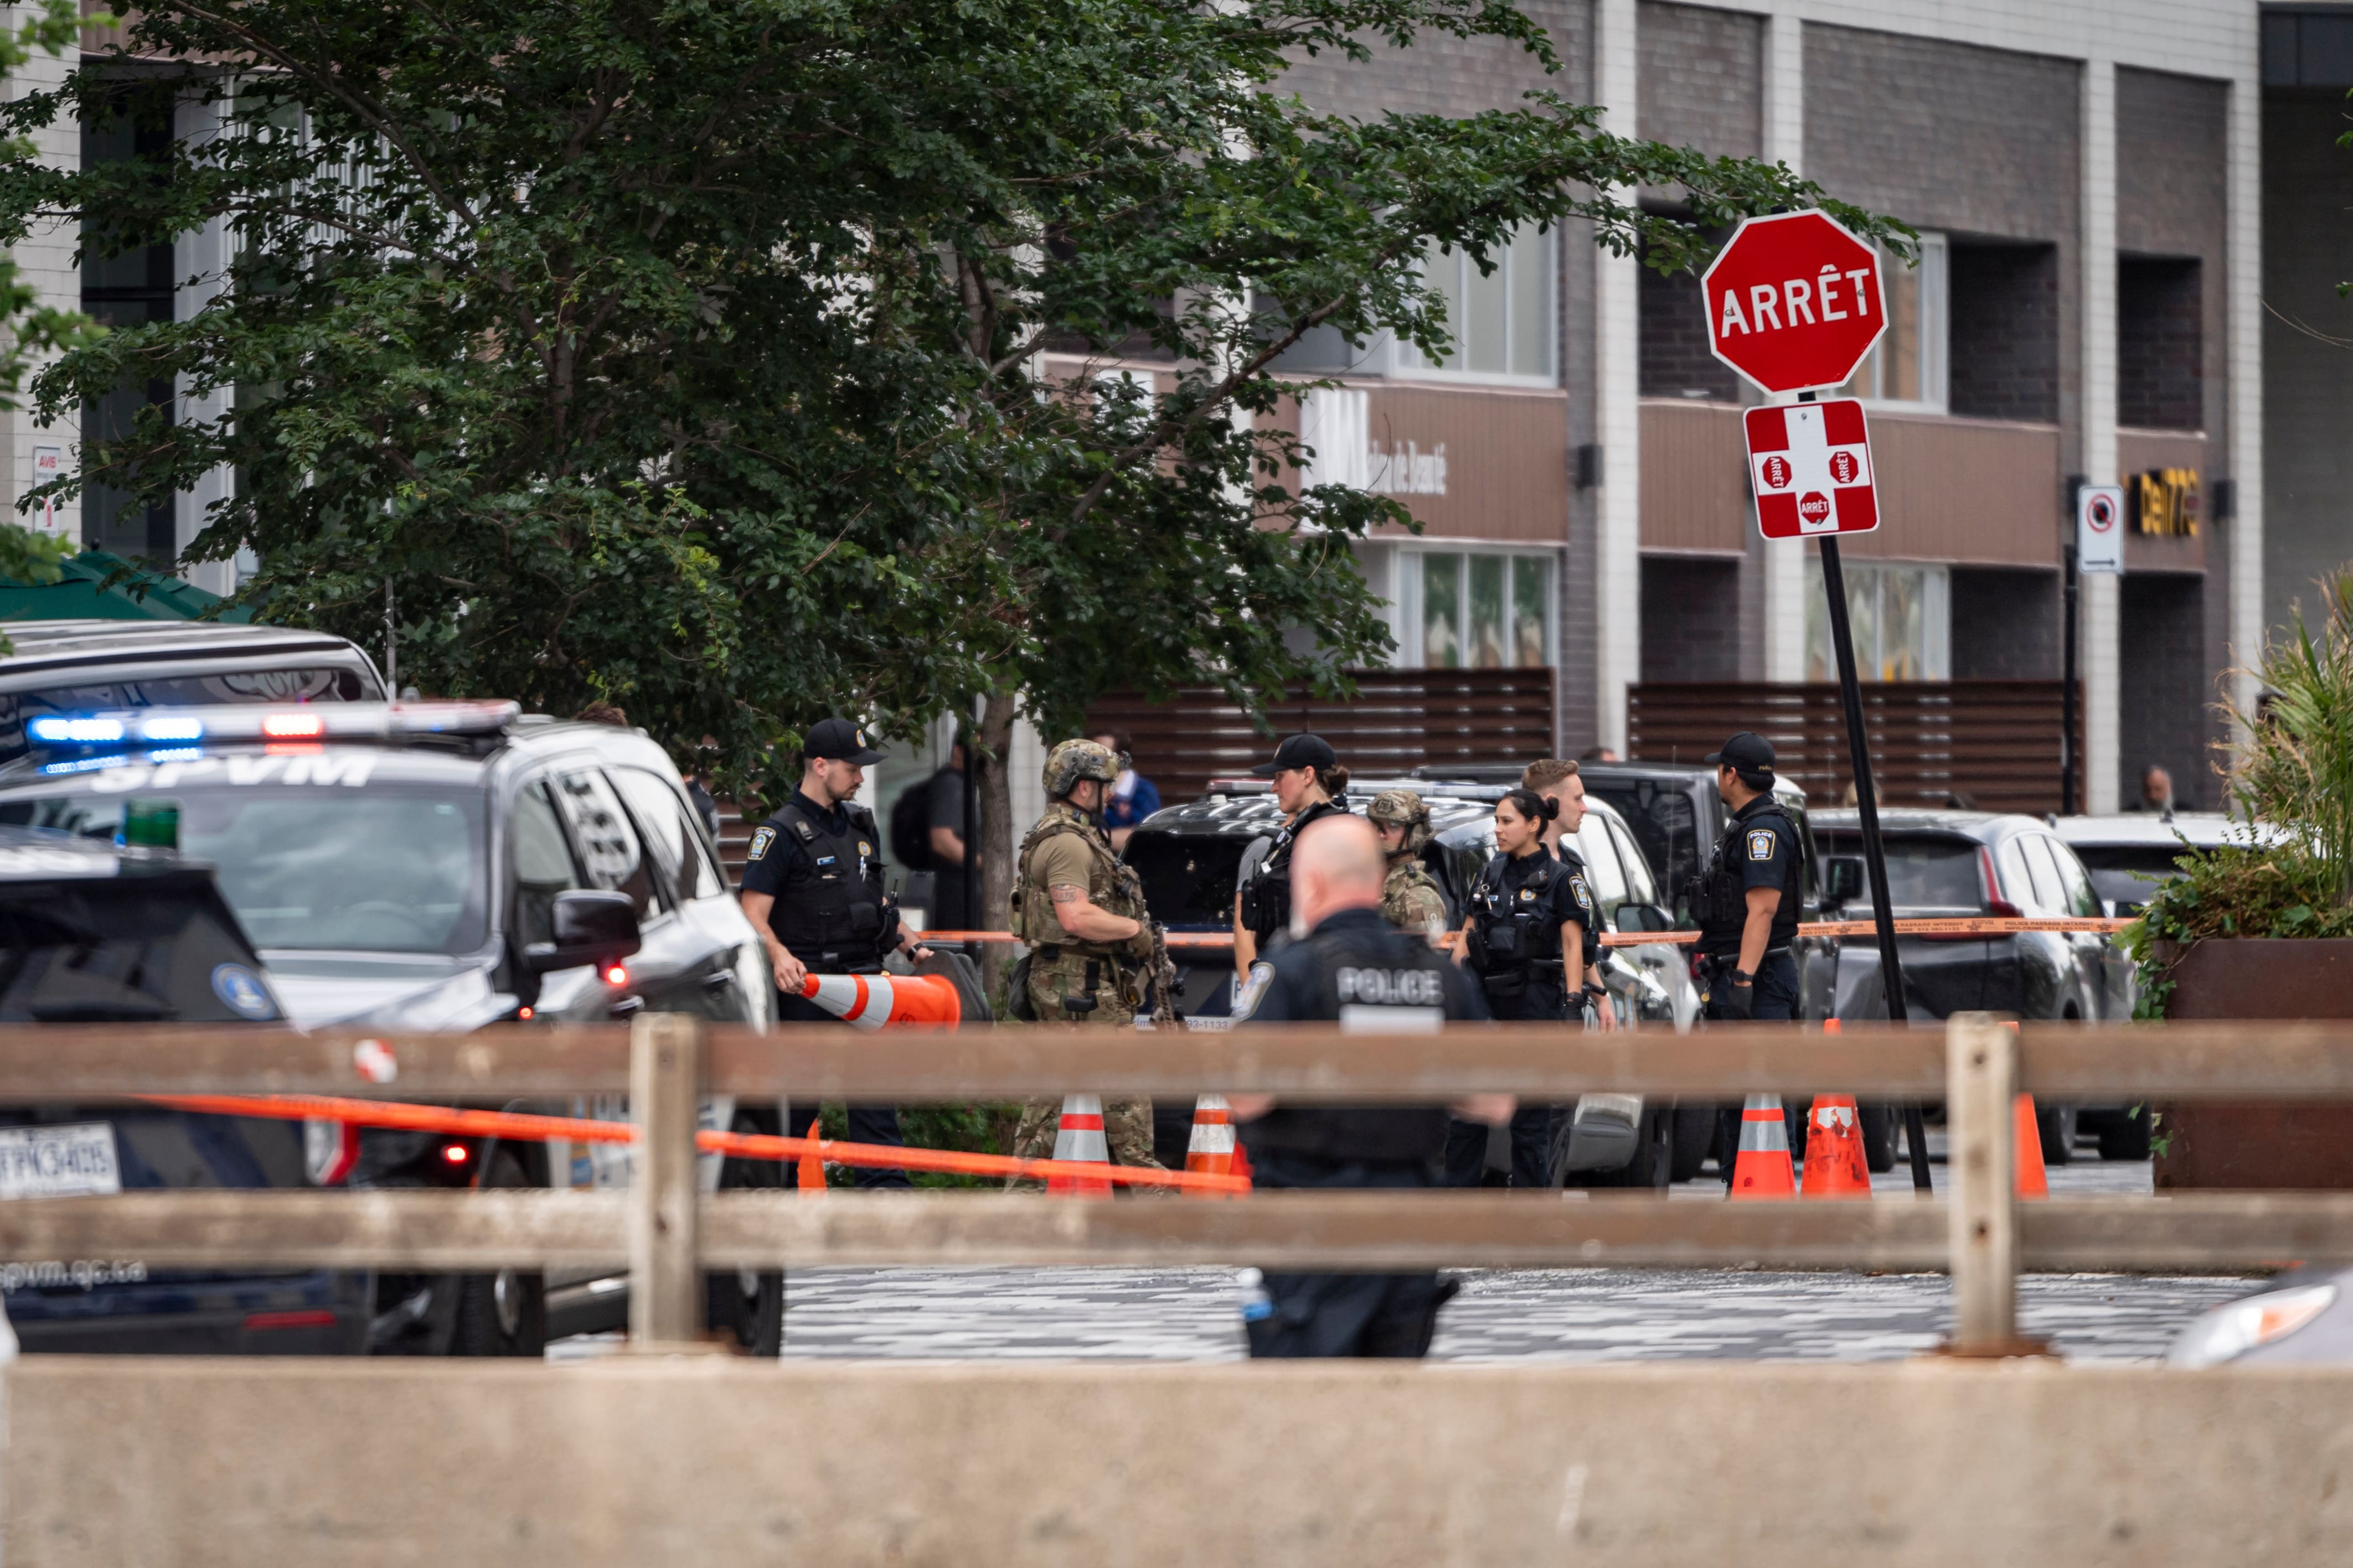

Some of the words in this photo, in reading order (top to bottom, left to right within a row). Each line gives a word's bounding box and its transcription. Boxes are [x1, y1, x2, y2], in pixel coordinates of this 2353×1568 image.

[1721, 263, 1870, 338] ARRÊT
[1771, 457, 1784, 488] ARRÊT
[1836, 452, 1850, 483] ARRÊT
[1802, 499, 1828, 513] ARRÊT
[1336, 966, 1444, 1006] POLICE
